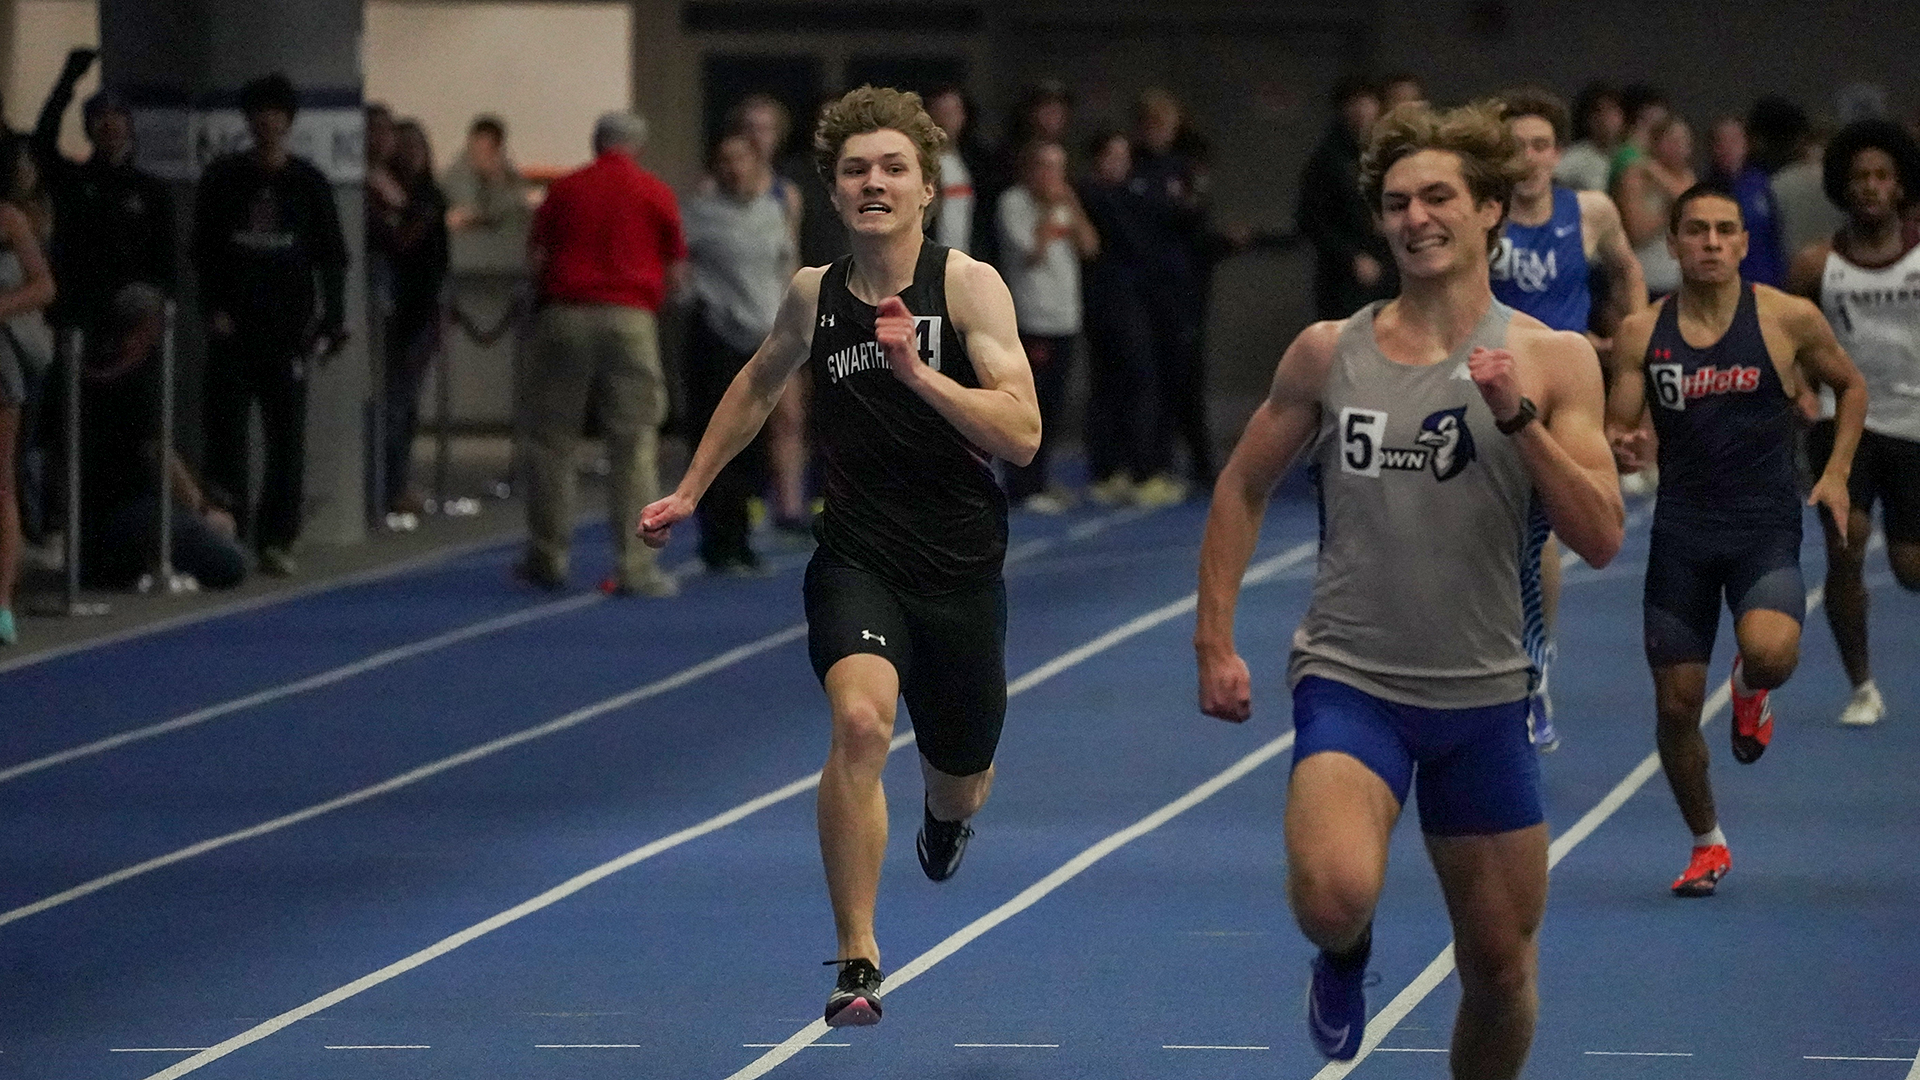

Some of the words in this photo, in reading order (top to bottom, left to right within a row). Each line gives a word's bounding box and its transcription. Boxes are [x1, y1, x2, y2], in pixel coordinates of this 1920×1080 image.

[1512, 248, 1558, 293] F&M
[827, 341, 893, 384] SWARTH
[1657, 369, 1678, 404] 6
[1346, 413, 1375, 470] 5
